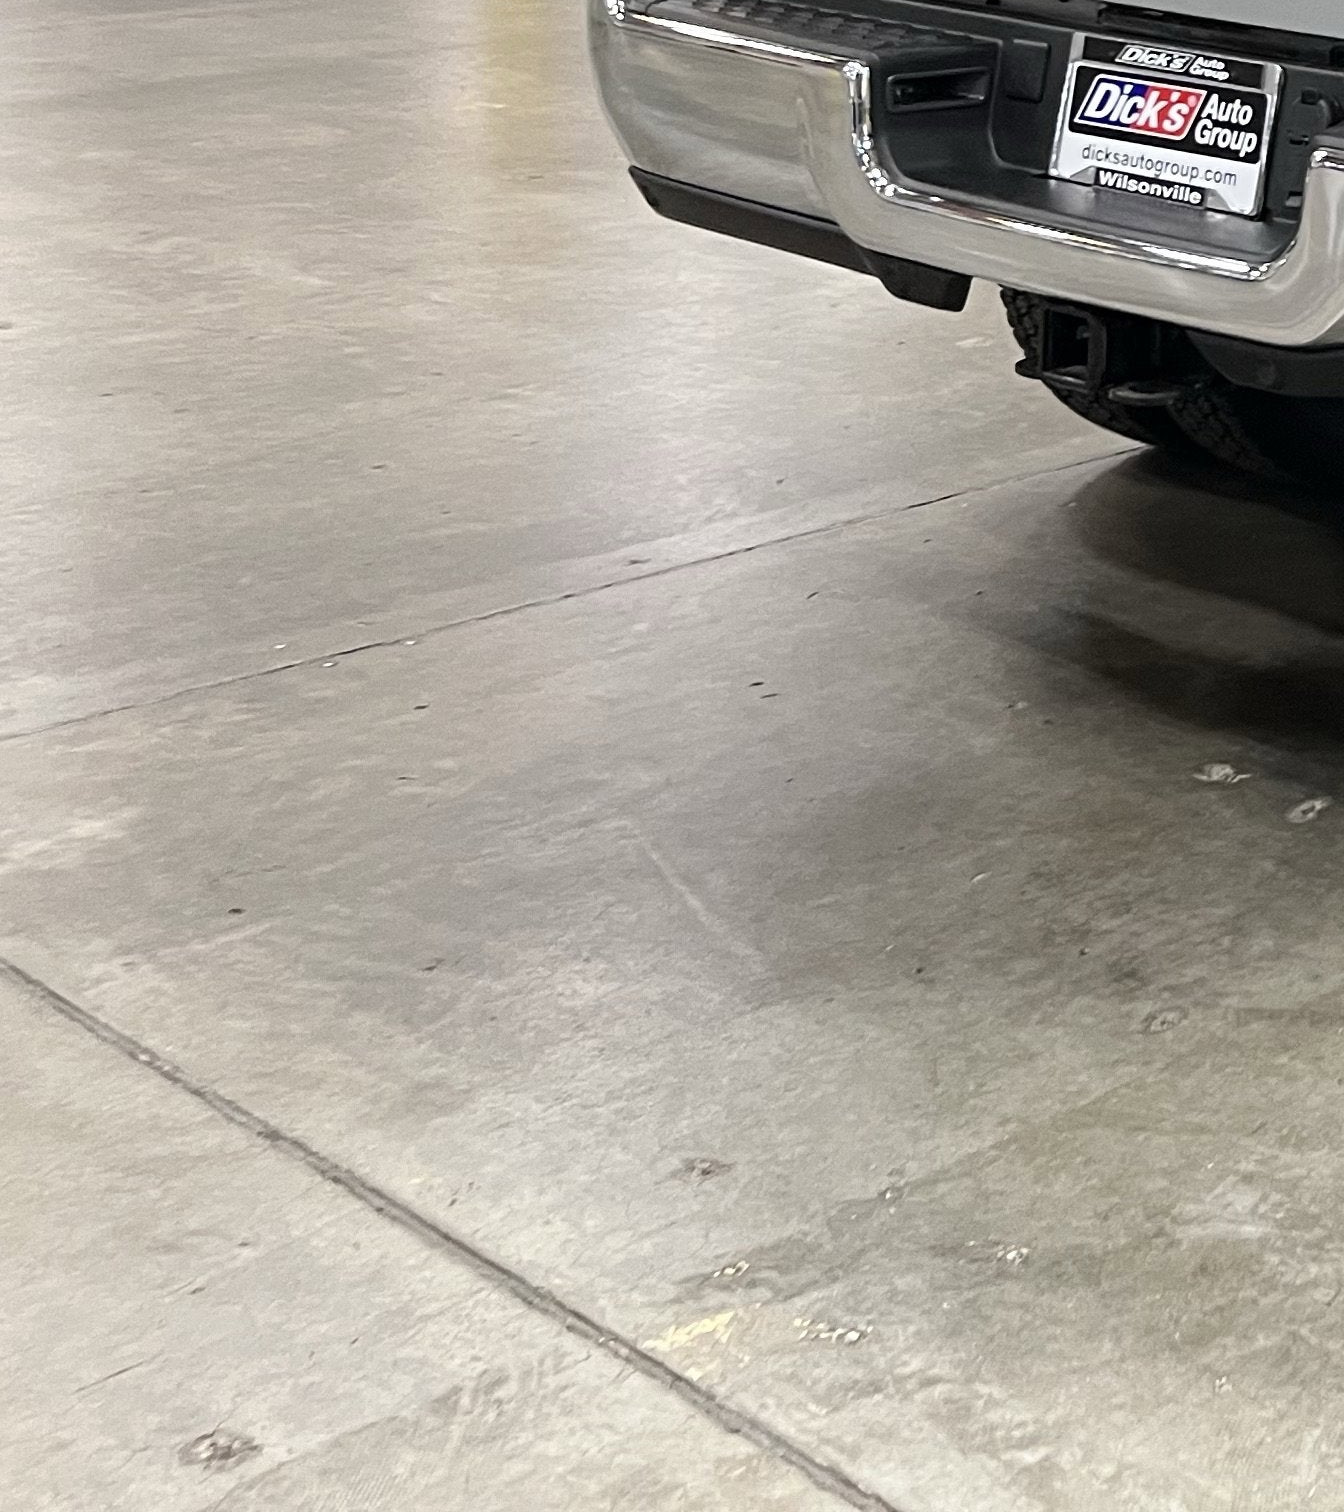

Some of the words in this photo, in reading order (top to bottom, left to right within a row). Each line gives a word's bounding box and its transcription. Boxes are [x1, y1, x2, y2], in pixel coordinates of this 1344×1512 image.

[1193, 57, 1225, 70] Auto
[1083, 82, 1193, 133] Dick's
[1201, 93, 1253, 126] Auto
[1194, 119, 1258, 158] Group
[1082, 143, 1237, 187] dicksautogroup.com
[1099, 169, 1203, 205] Wilsonville
